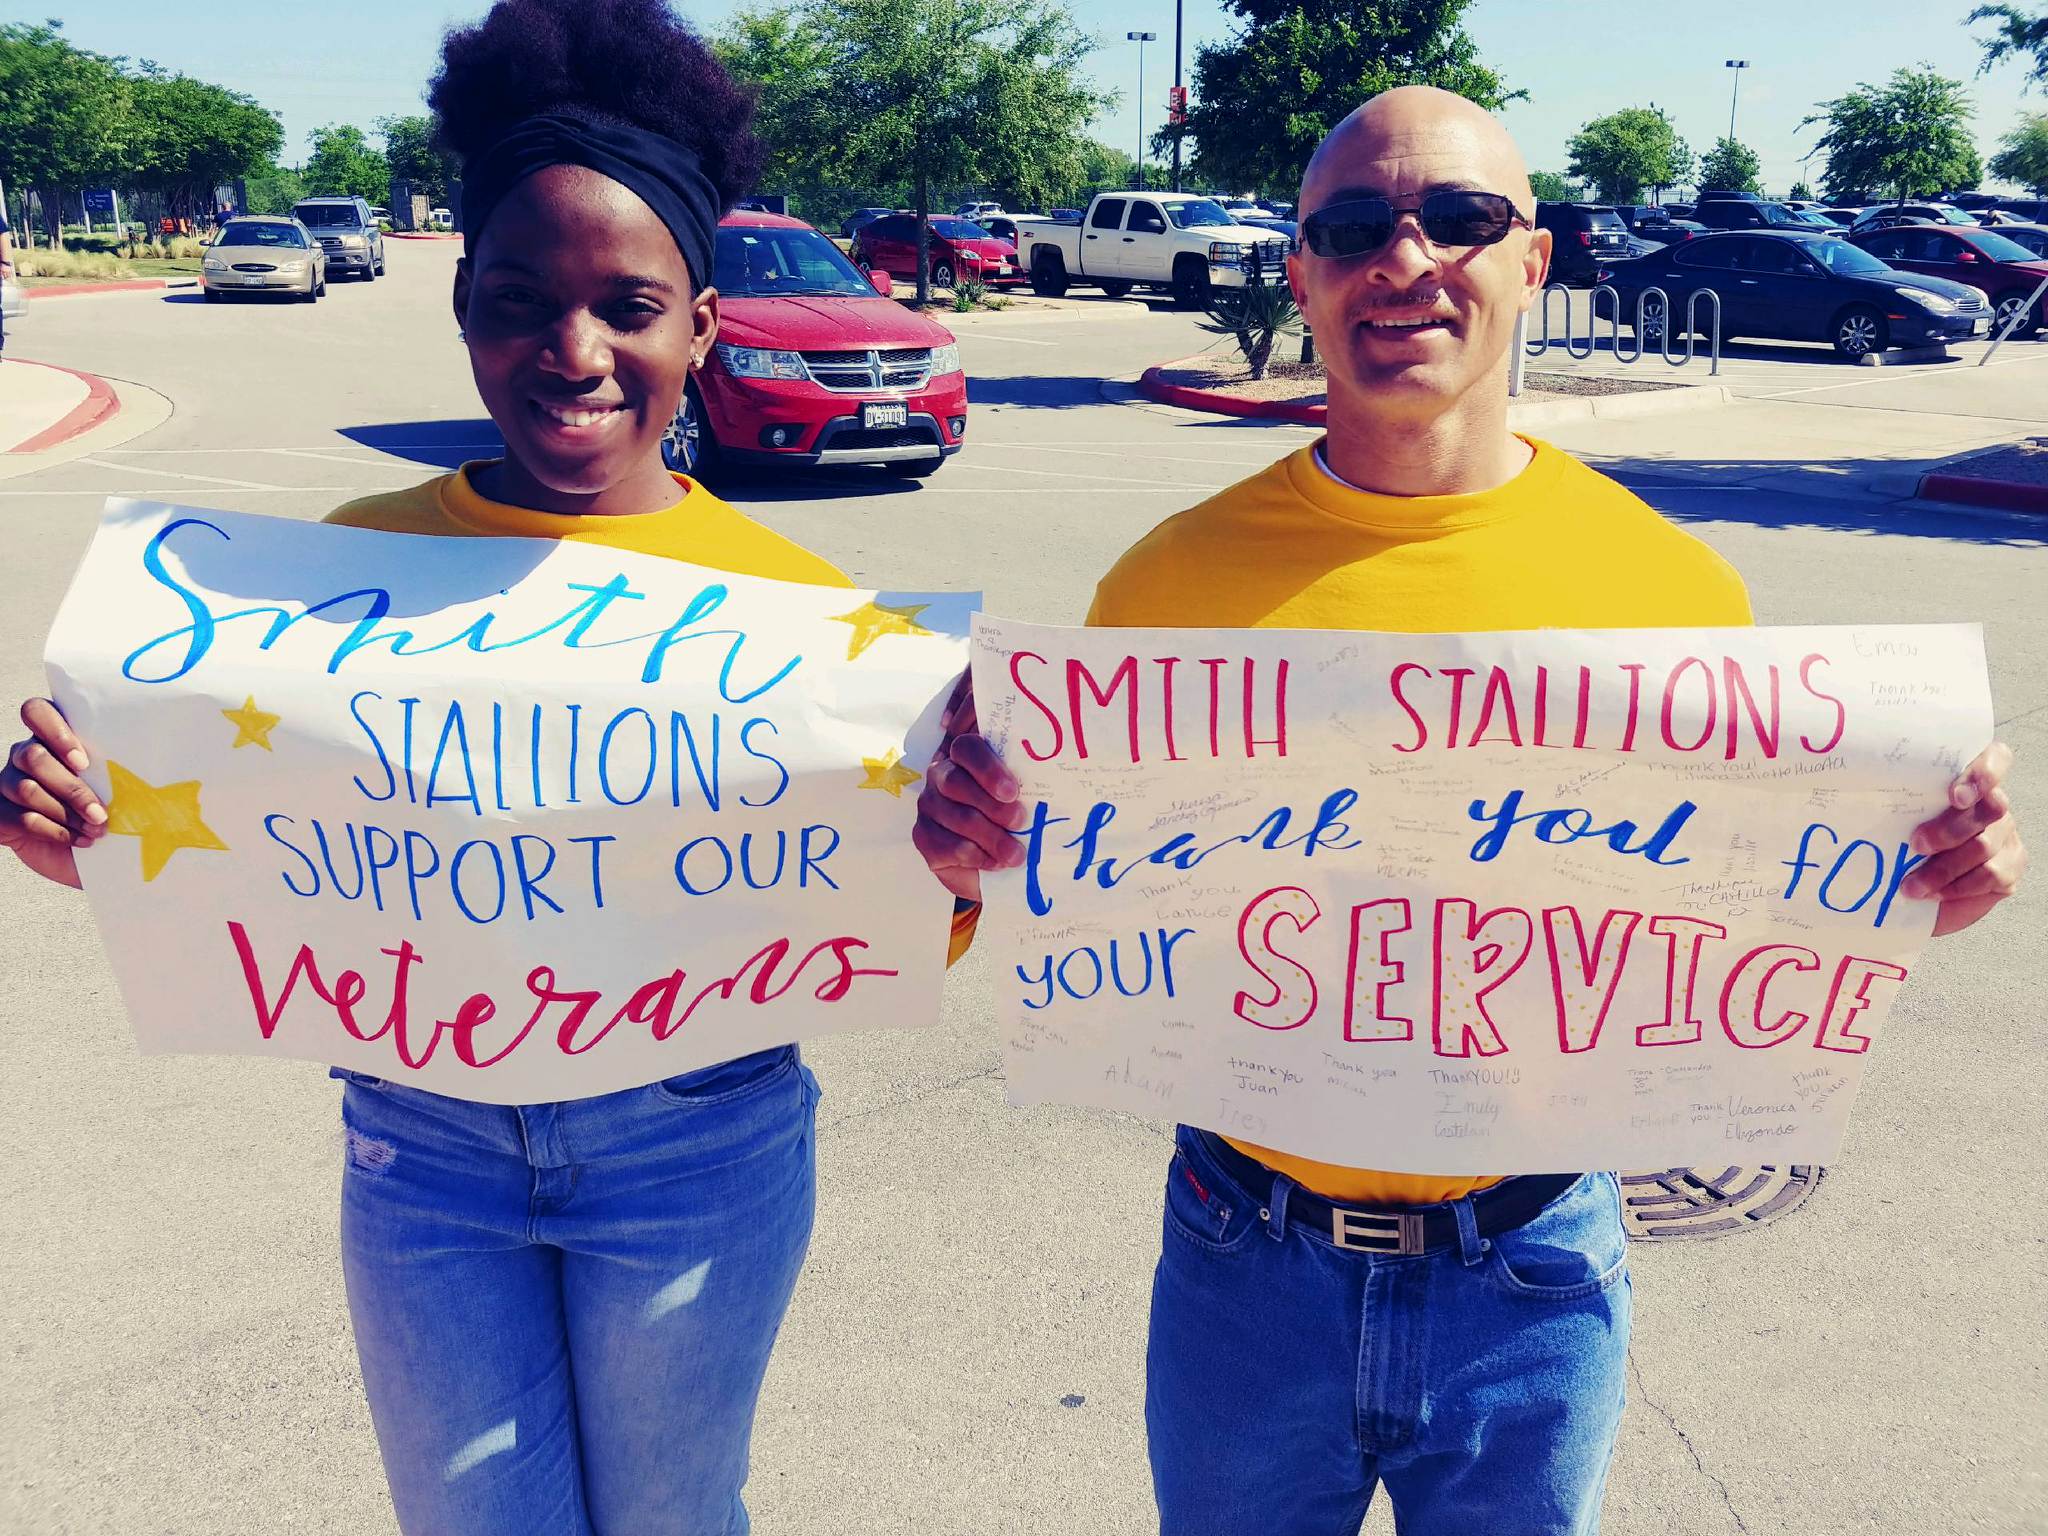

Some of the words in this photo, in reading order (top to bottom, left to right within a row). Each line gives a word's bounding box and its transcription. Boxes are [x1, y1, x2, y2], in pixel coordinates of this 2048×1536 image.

[122, 517, 803, 704] Smith
[350, 690, 790, 816] STALLIONS
[1009, 651, 1290, 763] SMITH
[1390, 653, 1846, 762] STALLIONS
[263, 814, 617, 924] SUPPORT
[674, 824, 840, 897] OUR
[1008, 787, 1360, 916] thank
[1467, 789, 1698, 866] you
[1780, 823, 1927, 928] for
[226, 921, 898, 1070] Veterans
[1016, 927, 1196, 1009] your
[1233, 885, 1909, 1059] SERVICE
